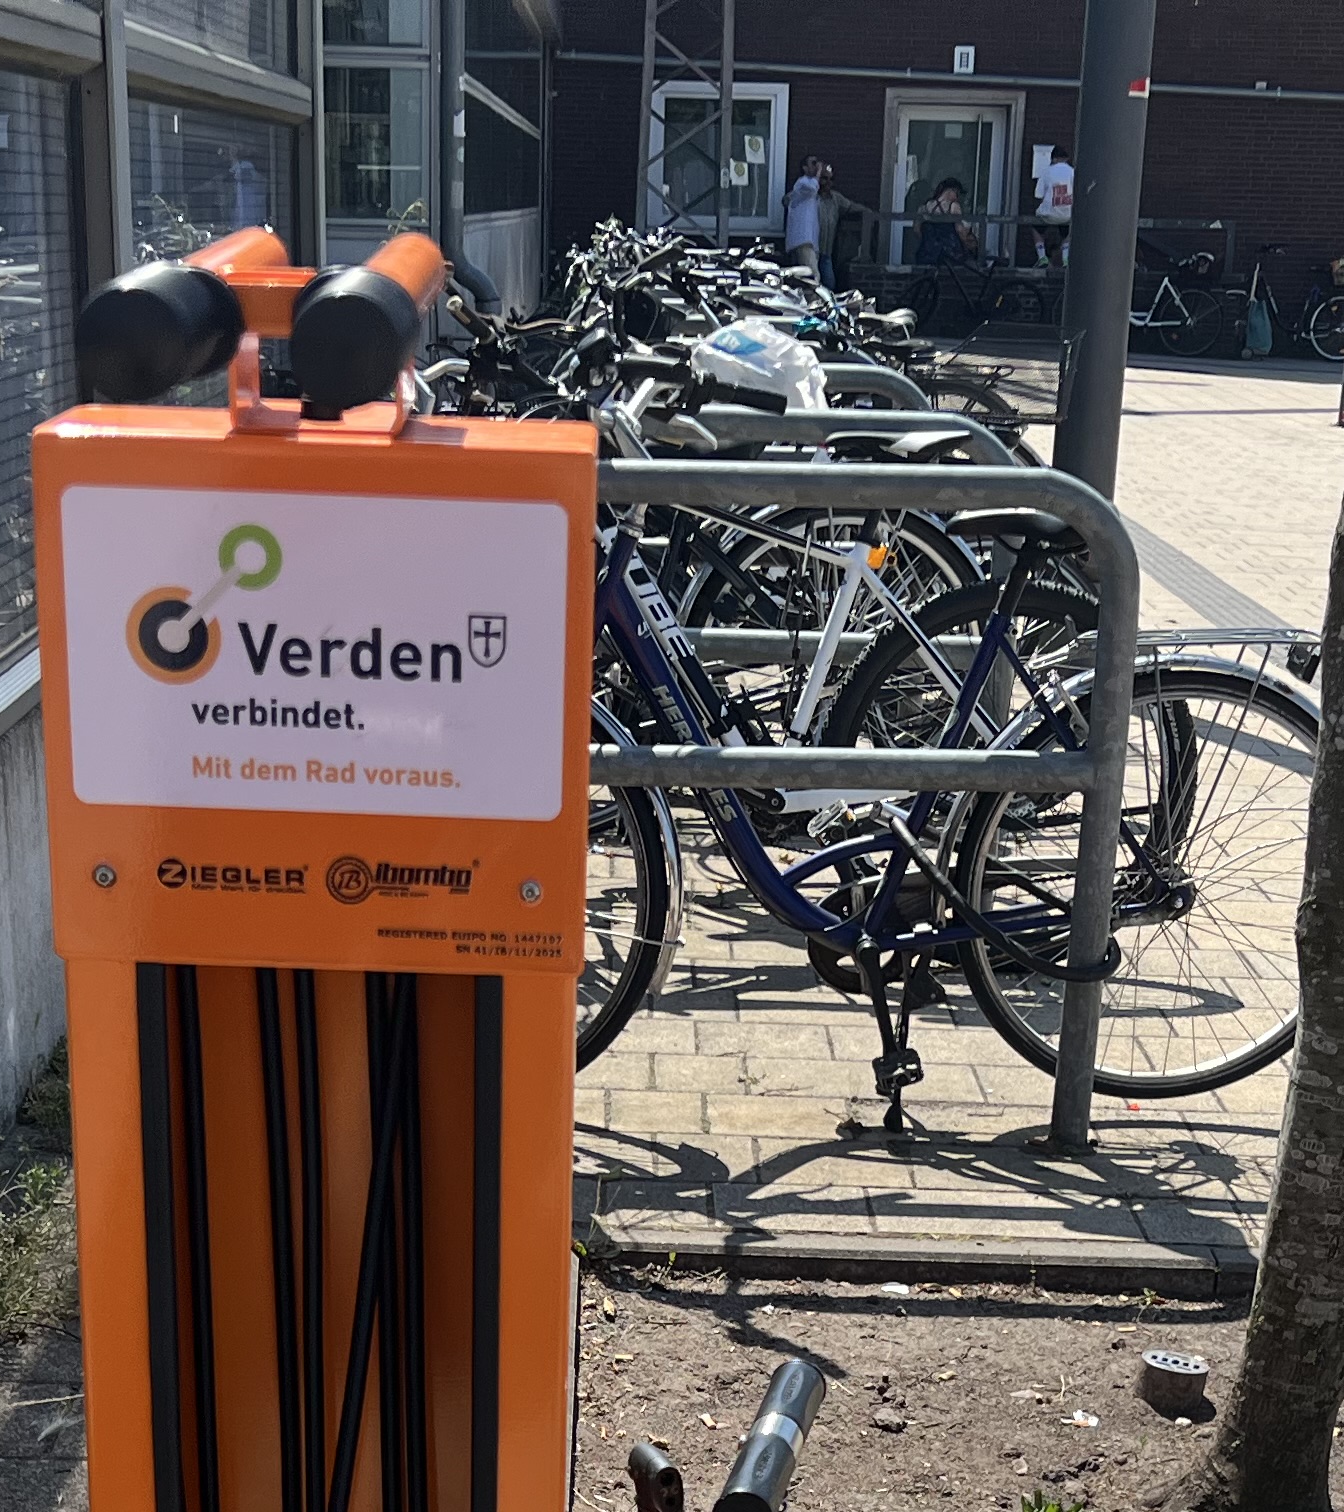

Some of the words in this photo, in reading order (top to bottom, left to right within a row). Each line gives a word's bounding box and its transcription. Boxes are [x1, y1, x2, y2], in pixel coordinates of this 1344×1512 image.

[237, 621, 462, 683] Verden
[191, 698, 365, 730] verbindet.
[191, 755, 233, 780] Mit
[240, 757, 297, 783] dem
[306, 759, 356, 784] Rad
[363, 762, 461, 788] voraus.
[157, 858, 305, 889] ZIEGLER
[377, 928, 448, 941] REGISTERED
